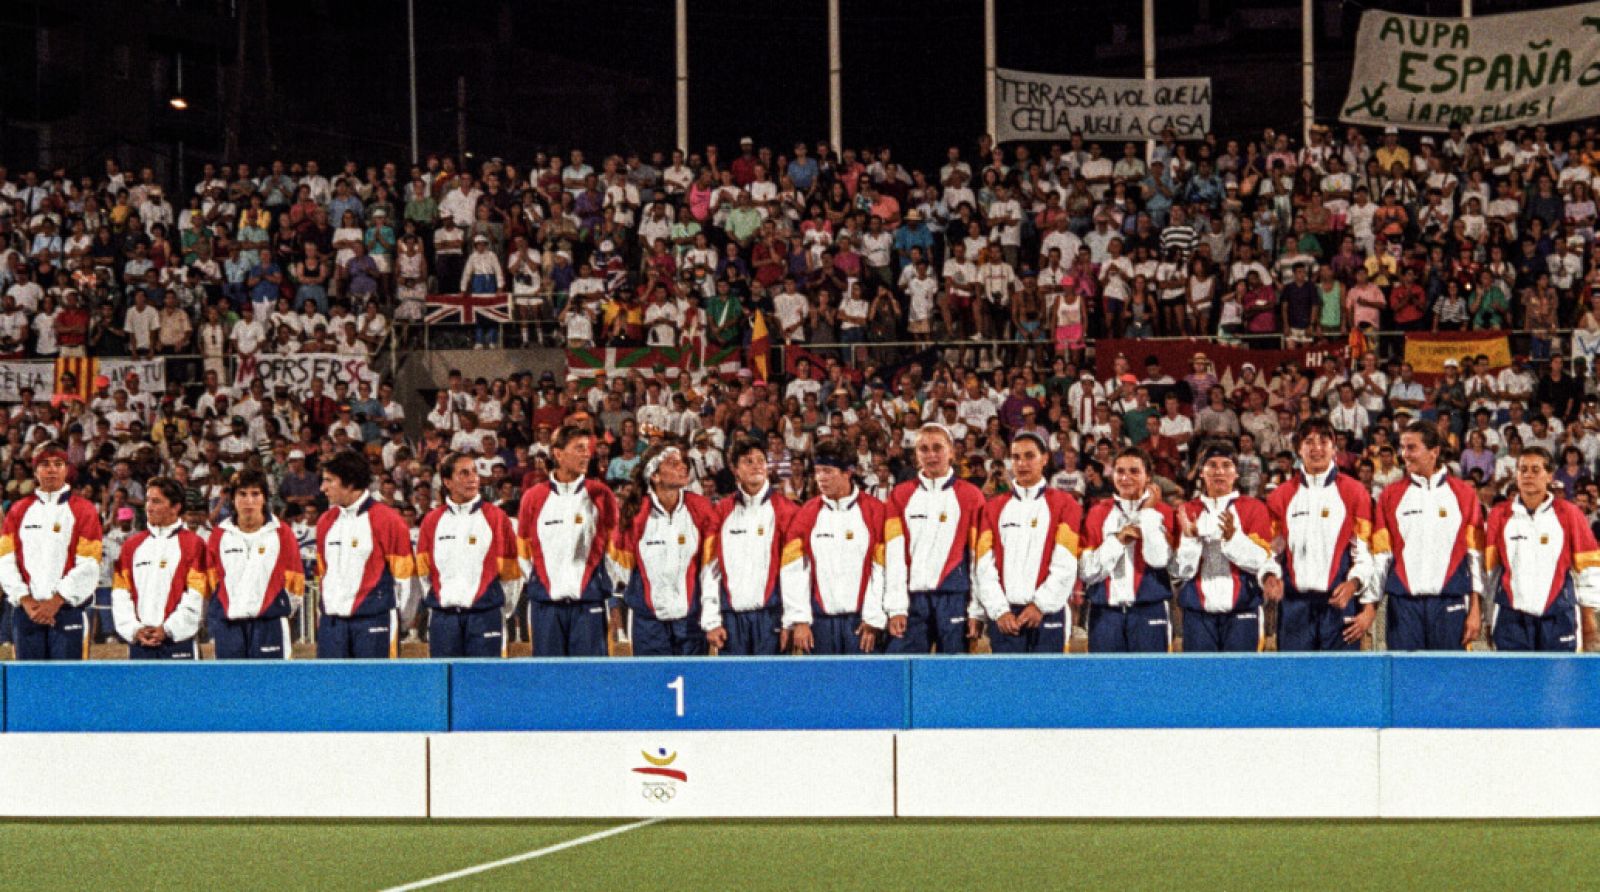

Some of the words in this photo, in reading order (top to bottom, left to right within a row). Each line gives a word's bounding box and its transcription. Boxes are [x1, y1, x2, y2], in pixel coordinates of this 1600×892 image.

[1379, 17, 1470, 49] AUPA
[1397, 38, 1573, 94] ESPAÑA
[998, 78, 1107, 107] TERRASSA
[1114, 88, 1151, 106] VOL
[1156, 85, 1188, 105] QUE
[1191, 84, 1211, 105] LA
[1127, 115, 1143, 135] A
[1148, 114, 1206, 136] CASA
[666, 675, 685, 717] 1
